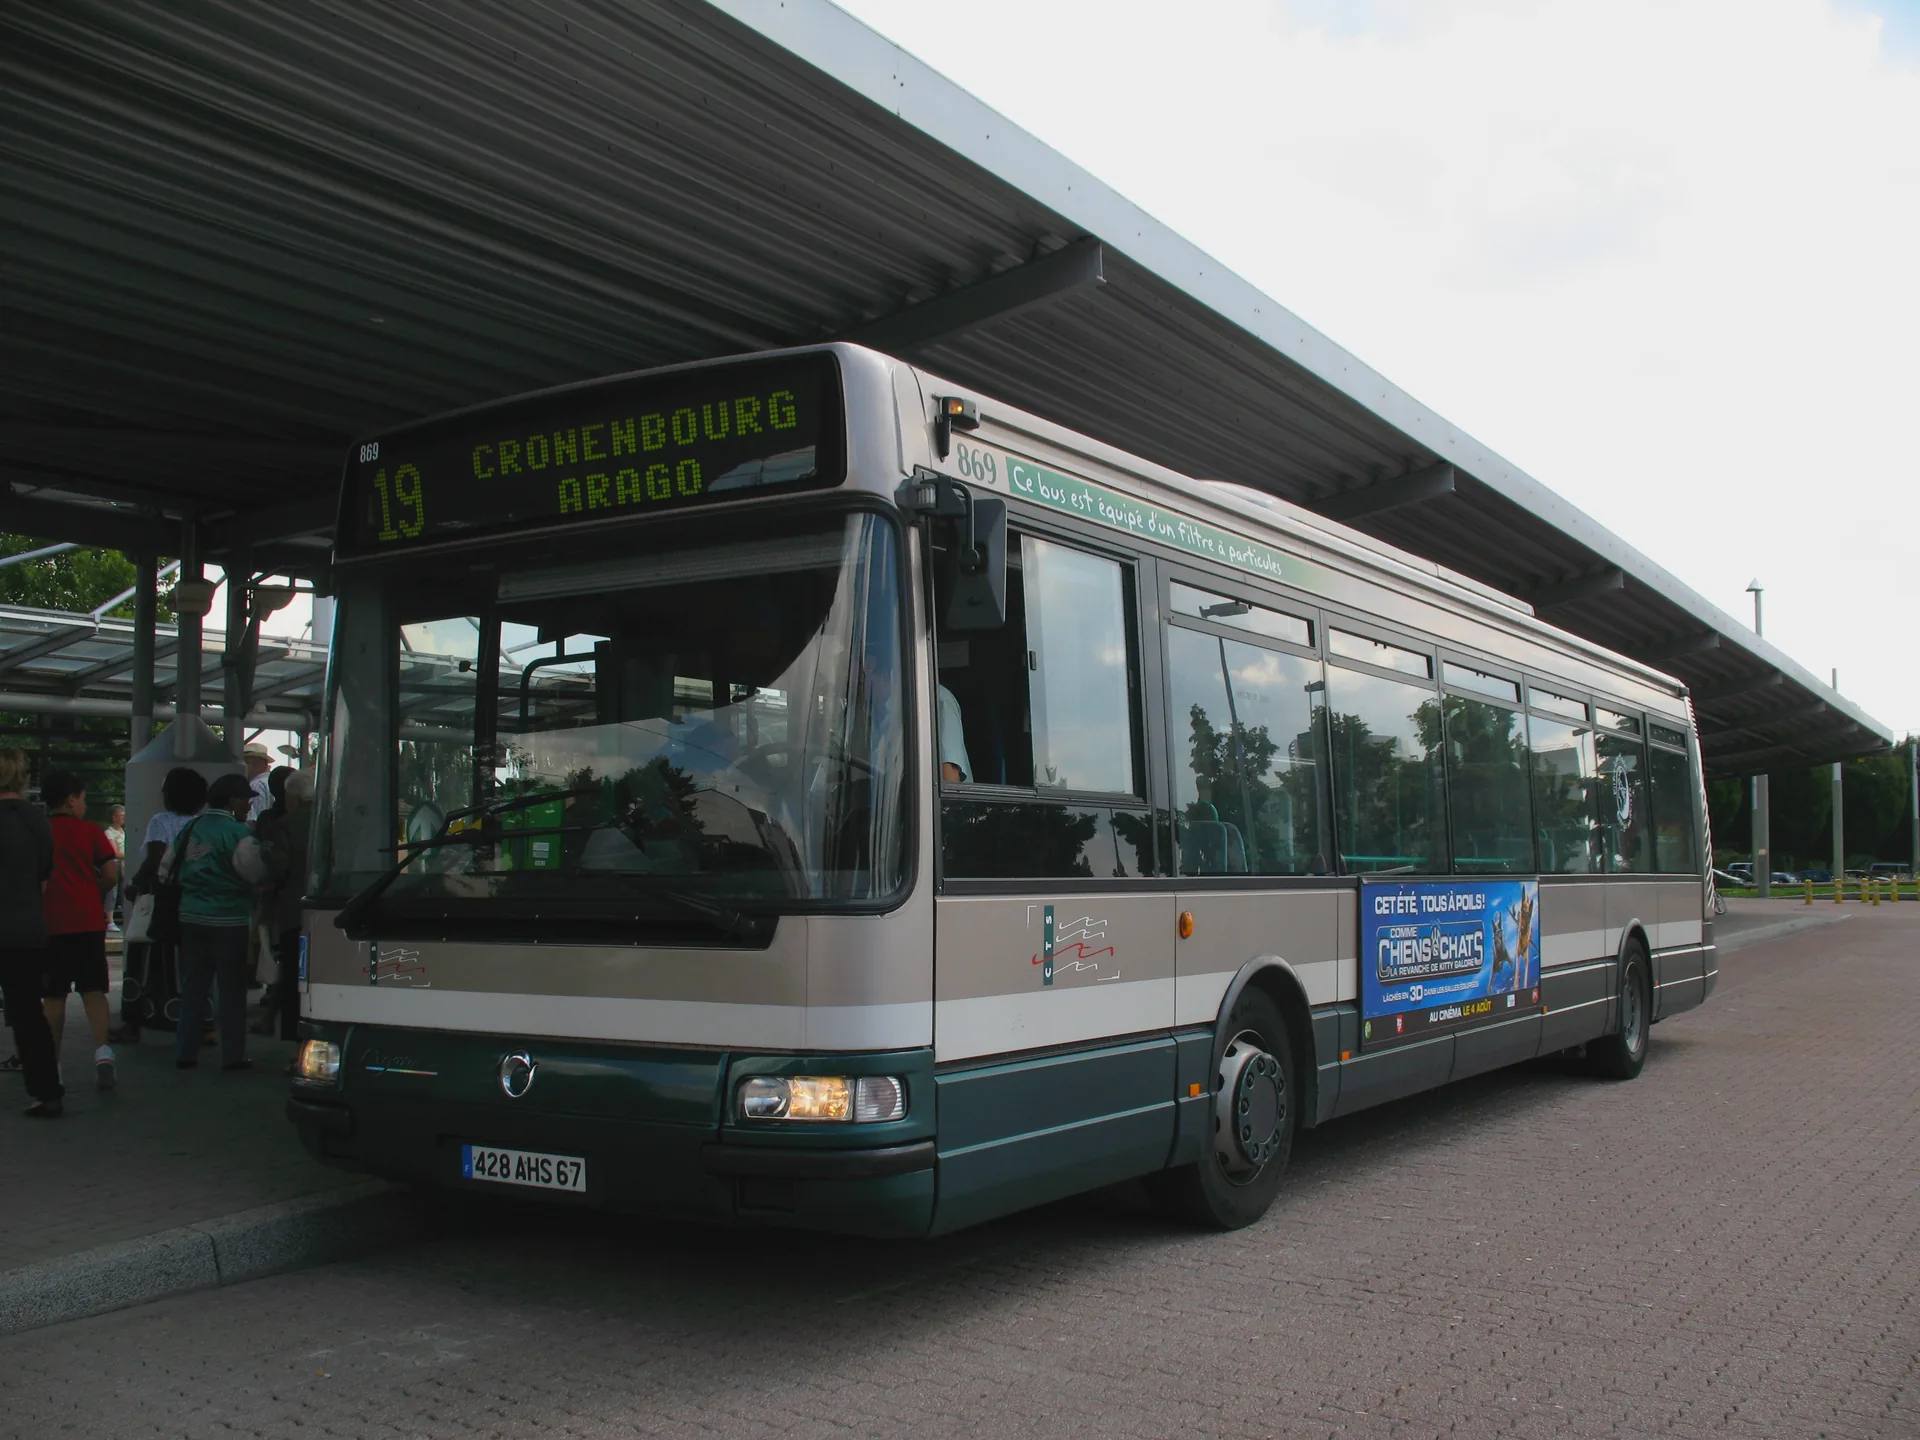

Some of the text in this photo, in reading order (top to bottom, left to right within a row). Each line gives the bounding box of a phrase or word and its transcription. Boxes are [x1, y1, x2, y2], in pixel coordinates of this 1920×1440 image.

[360, 442, 379, 463] 869
[473, 390, 797, 480] CRONENBOURG
[956, 443, 997, 485] 869
[374, 463, 424, 541] 19
[558, 459, 702, 514] ARAGO
[1013, 466, 1034, 493] Ce
[1037, 472, 1066, 504] bus
[1071, 488, 1093, 512] est
[1098, 497, 1144, 530] équipé
[1148, 511, 1176, 540] d'un
[1218, 540, 1226, 557] à
[1229, 545, 1283, 576] particules
[1375, 896, 1396, 914] CET
[1421, 895, 1447, 912] TOUS
[1390, 927, 1417, 938] COMME
[1379, 938, 1431, 977] CHIENS
[1440, 931, 1483, 966] CHATS
[1391, 959, 1475, 977] LA REVANCHE DE KITTY GALORE
[1410, 985, 1423, 1002] 3D
[1429, 1011, 1438, 1023] AU
[1439, 1006, 1462, 1021] CINÉMA
[1463, 1005, 1470, 1016] LE
[1471, 1003, 1476, 1014] 4
[475, 1151, 581, 1187] 428 AHS 67
